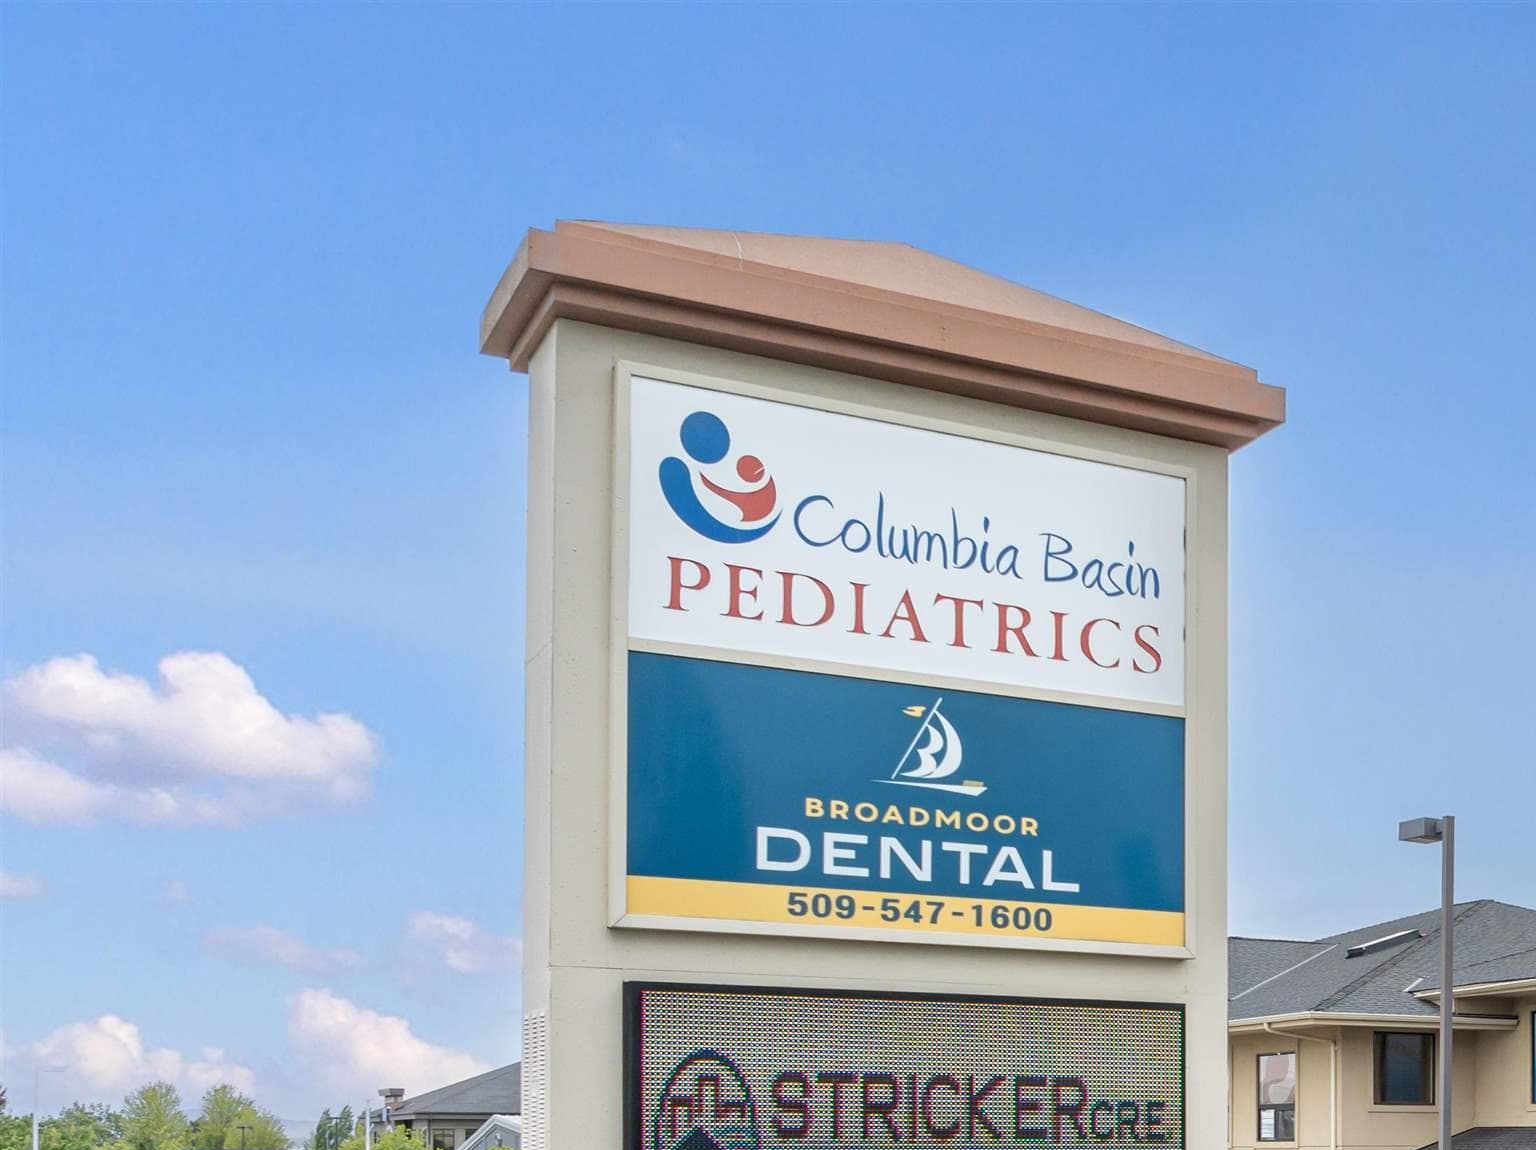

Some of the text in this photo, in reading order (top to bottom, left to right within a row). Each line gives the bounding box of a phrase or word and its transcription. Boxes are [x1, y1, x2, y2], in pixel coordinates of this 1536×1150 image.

[793, 491, 1161, 600] Columbia Basin
[662, 556, 1163, 674] PEDIATRICS
[805, 796, 1040, 836] BROADMOOR
[755, 826, 1080, 894] DENTAL
[786, 891, 1053, 932] 509-547-1600
